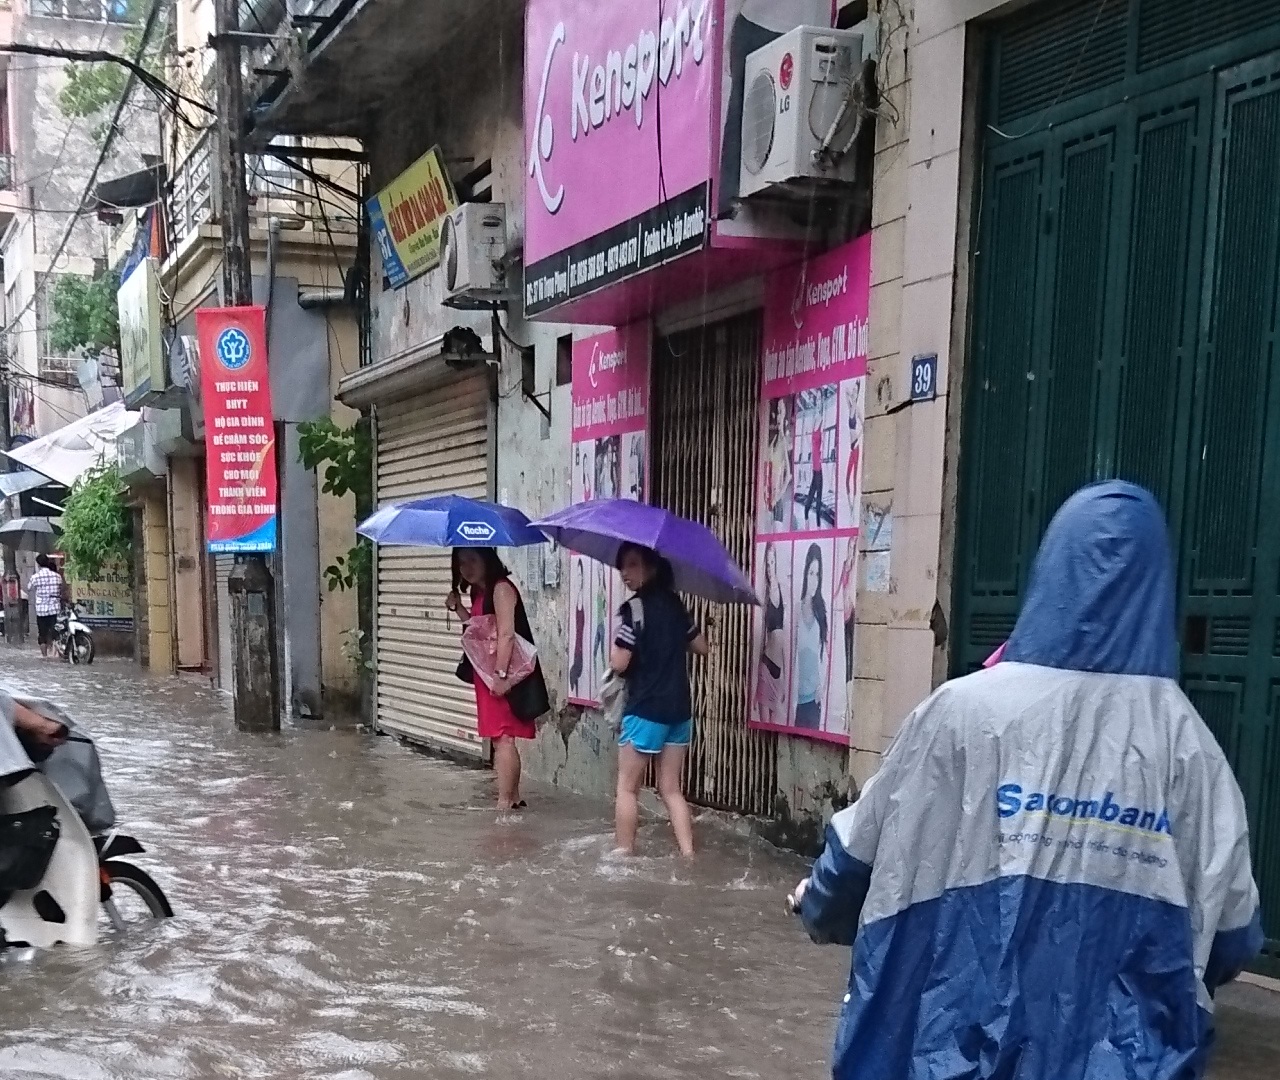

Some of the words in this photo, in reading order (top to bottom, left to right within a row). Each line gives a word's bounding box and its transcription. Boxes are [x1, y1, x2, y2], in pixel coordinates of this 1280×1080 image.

[572, 0, 704, 139] Kensport
[780, 94, 790, 114] LG
[806, 265, 847, 307] Kensport
[599, 343, 627, 373] Kensport
[915, 362, 932, 394] 39
[215, 381, 237, 393] THỰC
[237, 380, 259, 393] HIỆN
[225, 399, 248, 410] BHYT
[214, 416, 225, 429] HỘ
[226, 416, 240, 427] GIA
[240, 415, 264, 427] ĐÌNH
[248, 433, 269, 445] SÓC
[223, 469, 239, 480] CHO
[245, 485, 267, 497] VIÊN
[210, 504, 236, 515] TRONG
[237, 504, 253, 515] GIA
[254, 503, 276, 515] ĐÌNH
[463, 525, 490, 535] Roche
